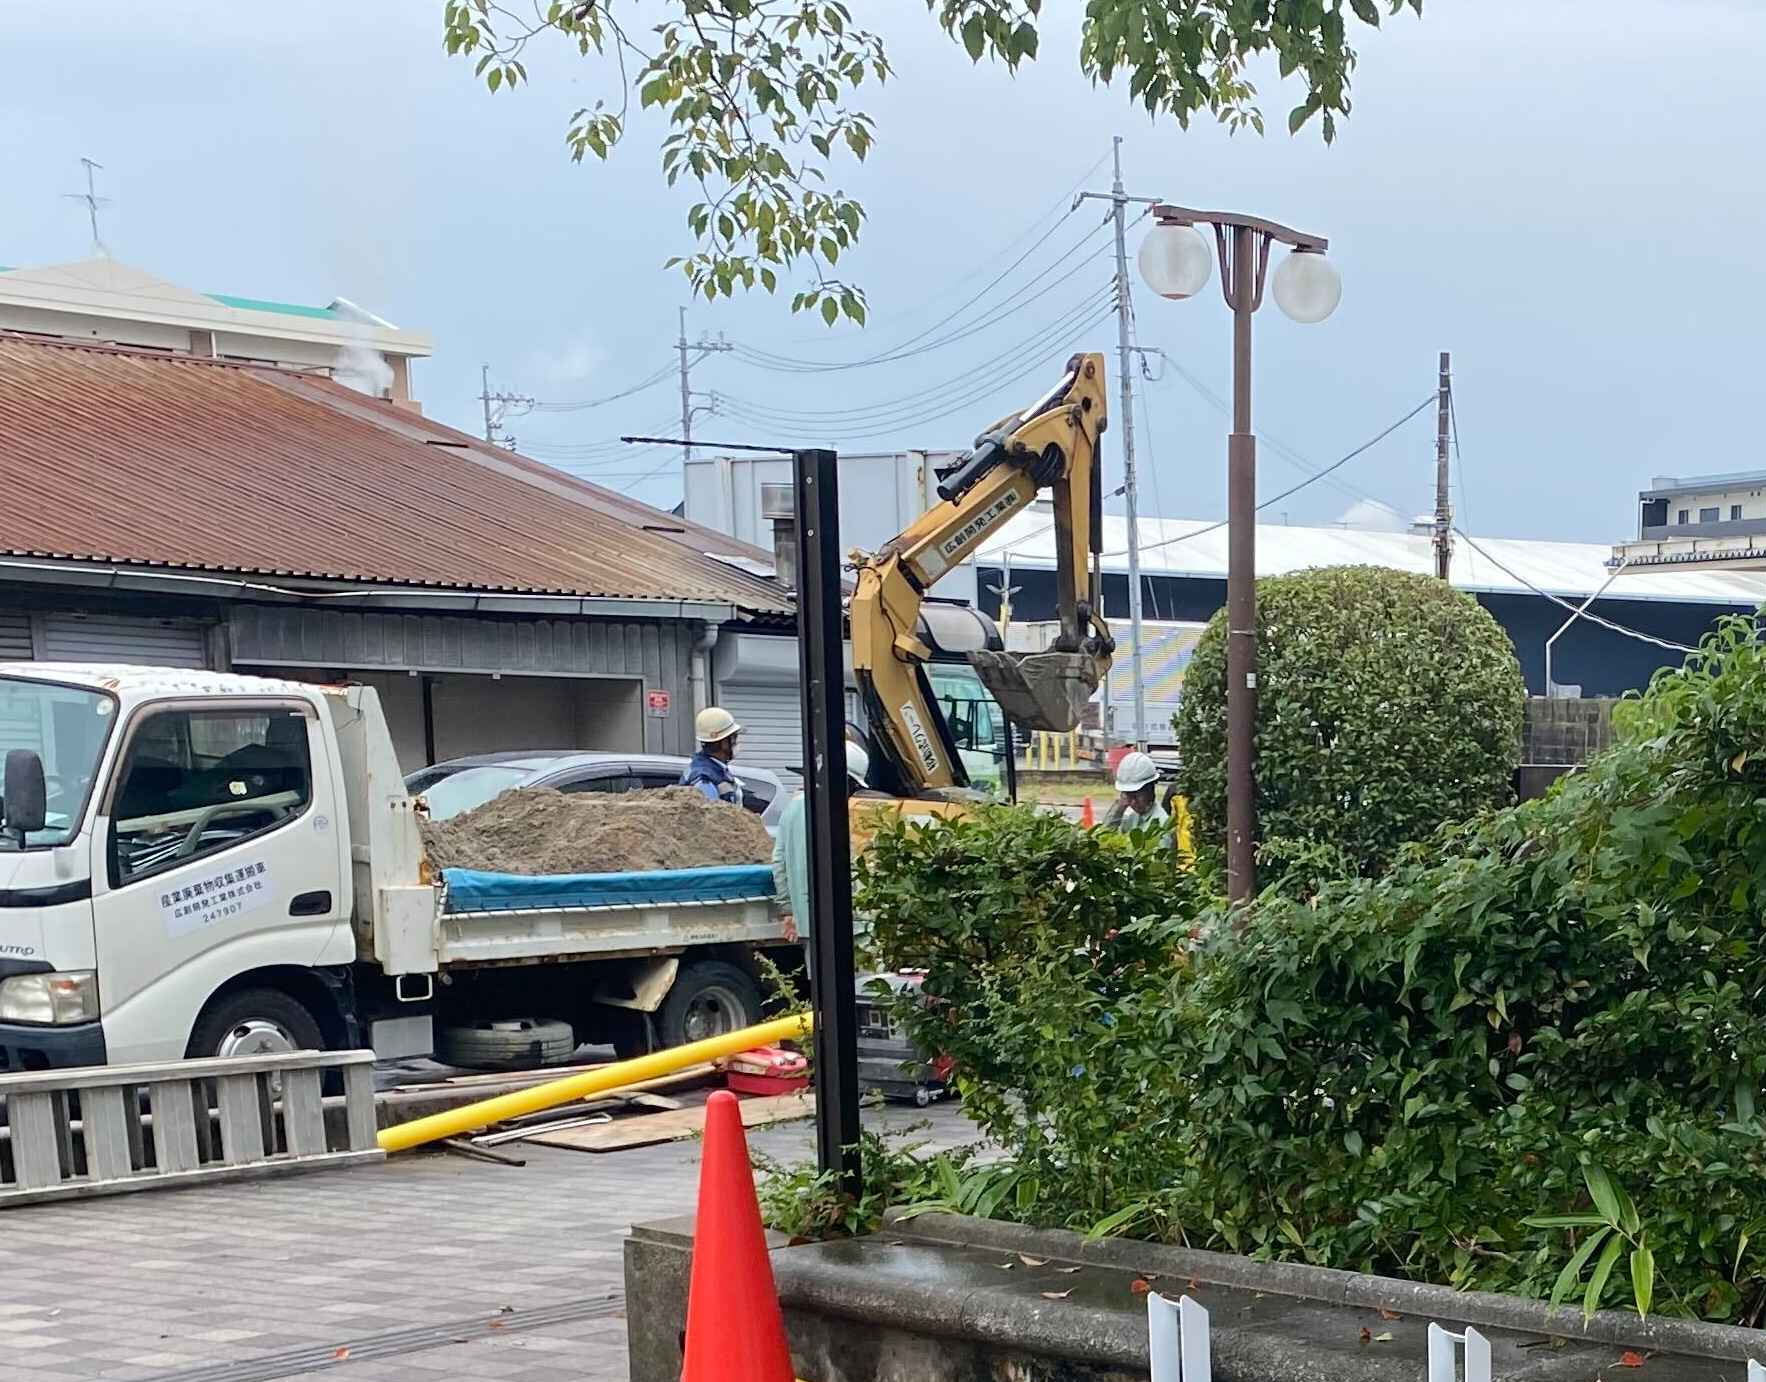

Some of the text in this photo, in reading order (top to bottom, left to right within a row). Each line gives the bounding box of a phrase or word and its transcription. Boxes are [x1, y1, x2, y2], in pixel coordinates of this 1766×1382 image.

[161, 861, 267, 908] 産業廃棄物収集運搬車
[203, 902, 242, 923] 247907
